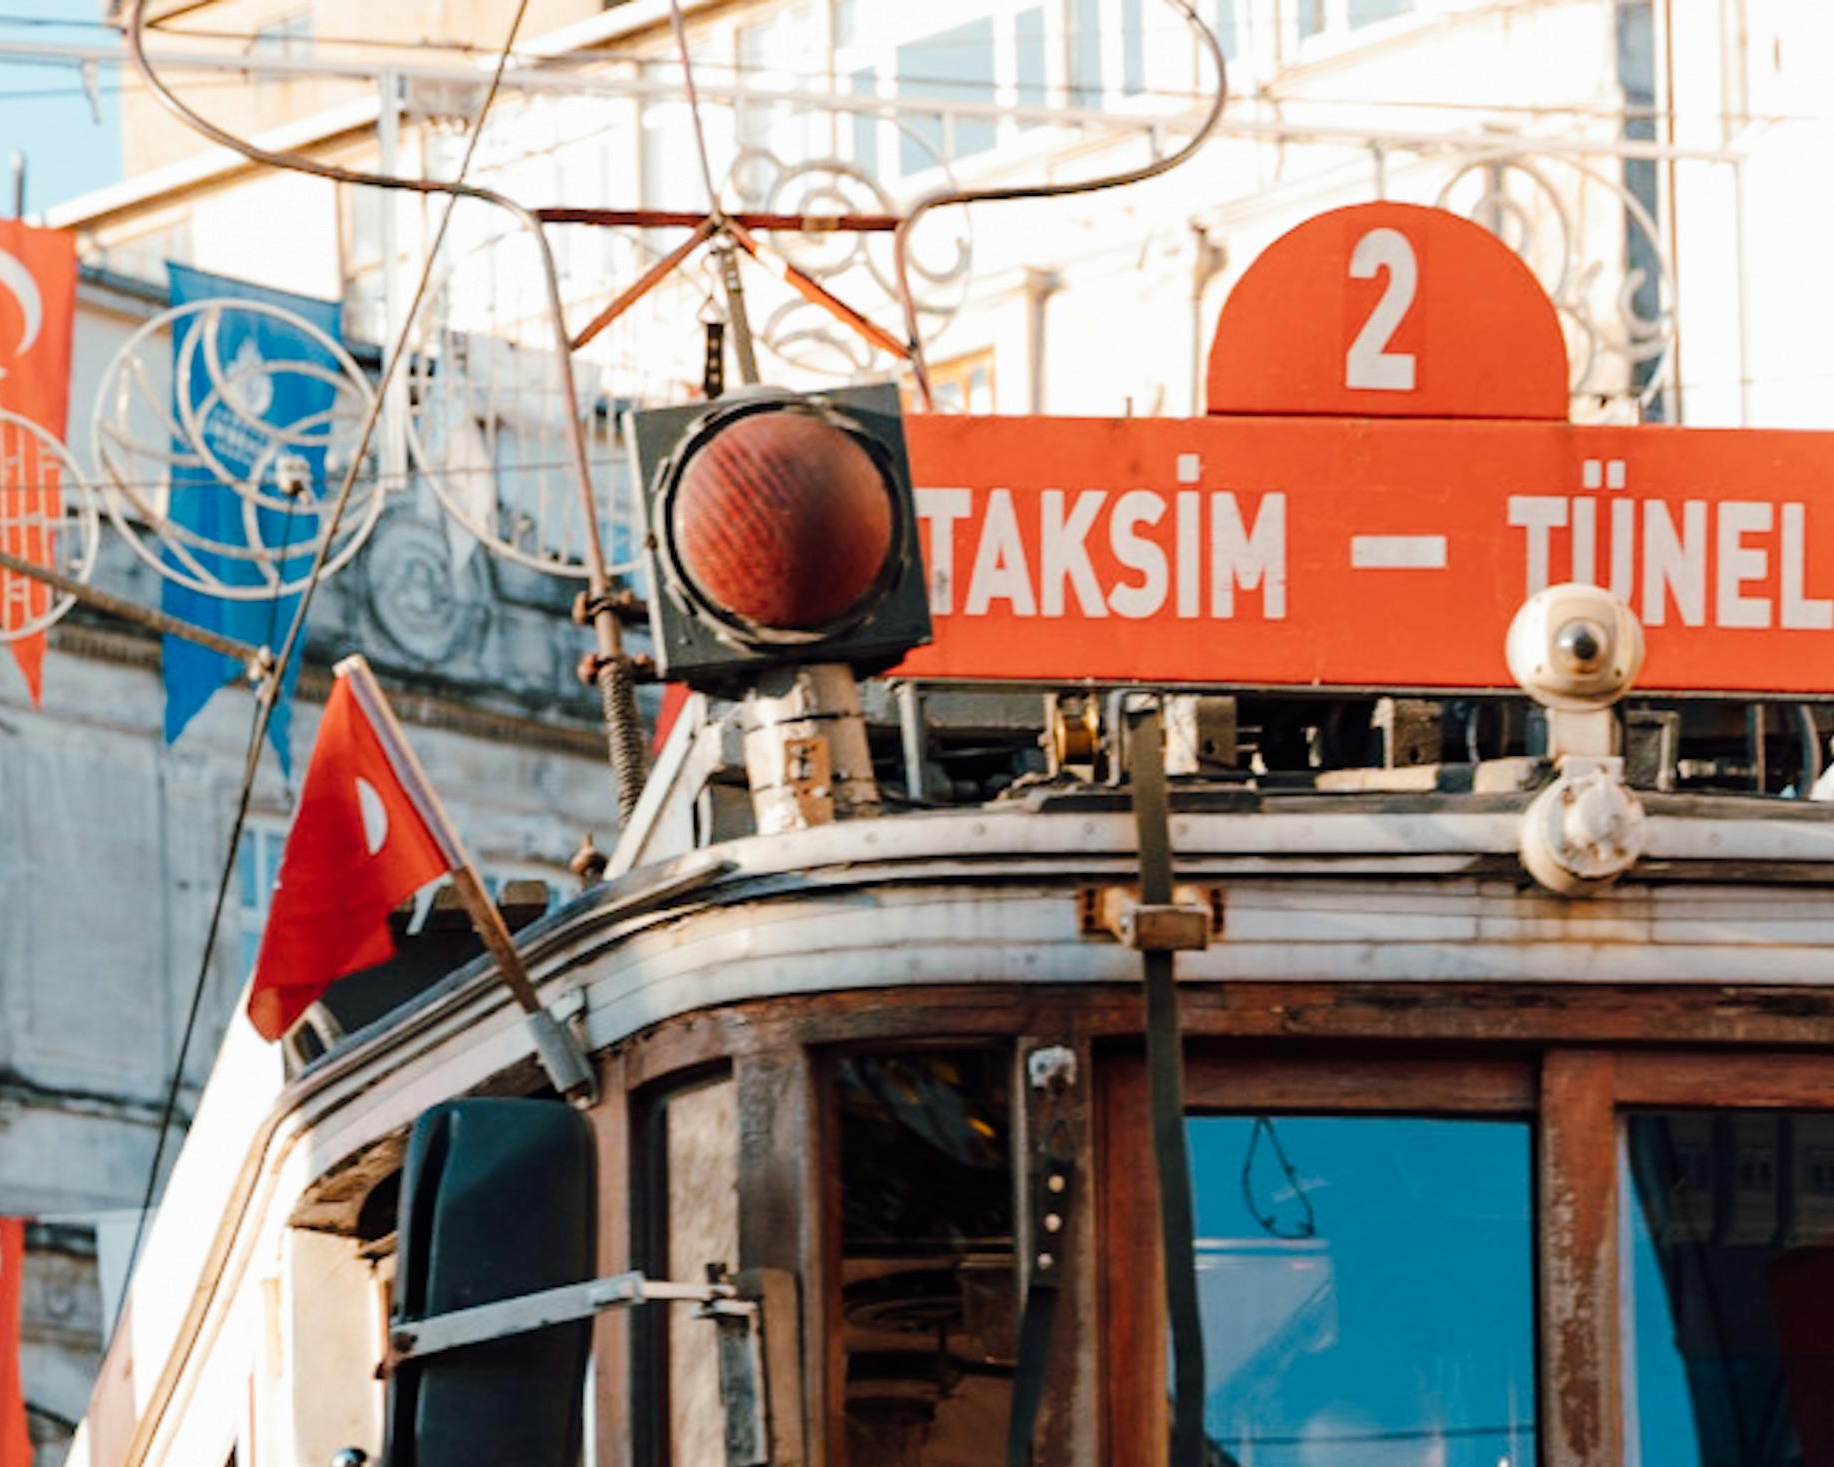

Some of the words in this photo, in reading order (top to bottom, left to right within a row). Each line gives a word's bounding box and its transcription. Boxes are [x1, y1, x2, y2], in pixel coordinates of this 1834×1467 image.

[1345, 228, 1419, 392] 2
[913, 453, 1287, 619] TAKSİM
[1508, 459, 1834, 629] TÜNEL
